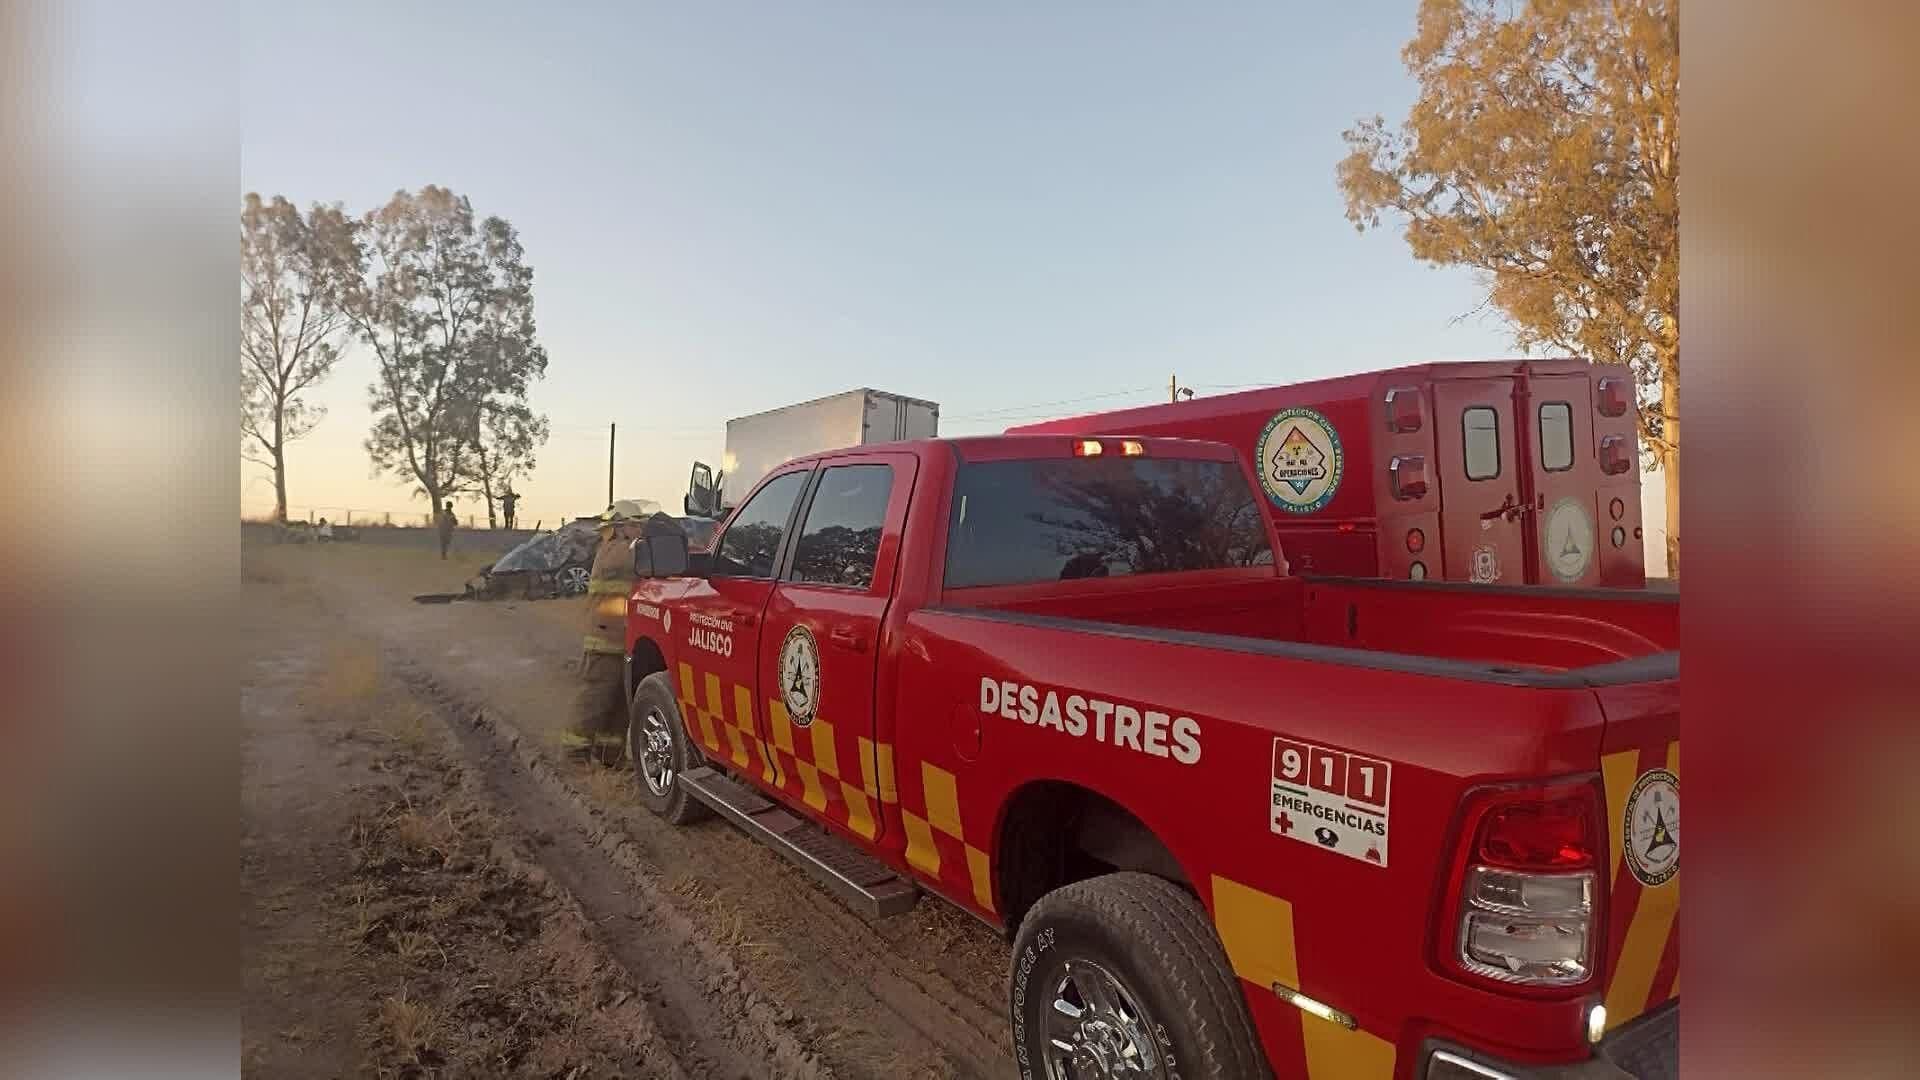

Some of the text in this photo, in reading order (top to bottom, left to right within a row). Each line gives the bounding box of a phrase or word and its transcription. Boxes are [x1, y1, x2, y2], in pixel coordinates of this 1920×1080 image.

[688, 627, 732, 657] JALISCO
[980, 677, 1202, 766] DESASTRES
[1272, 793, 1386, 837] EMERGENCIAS
